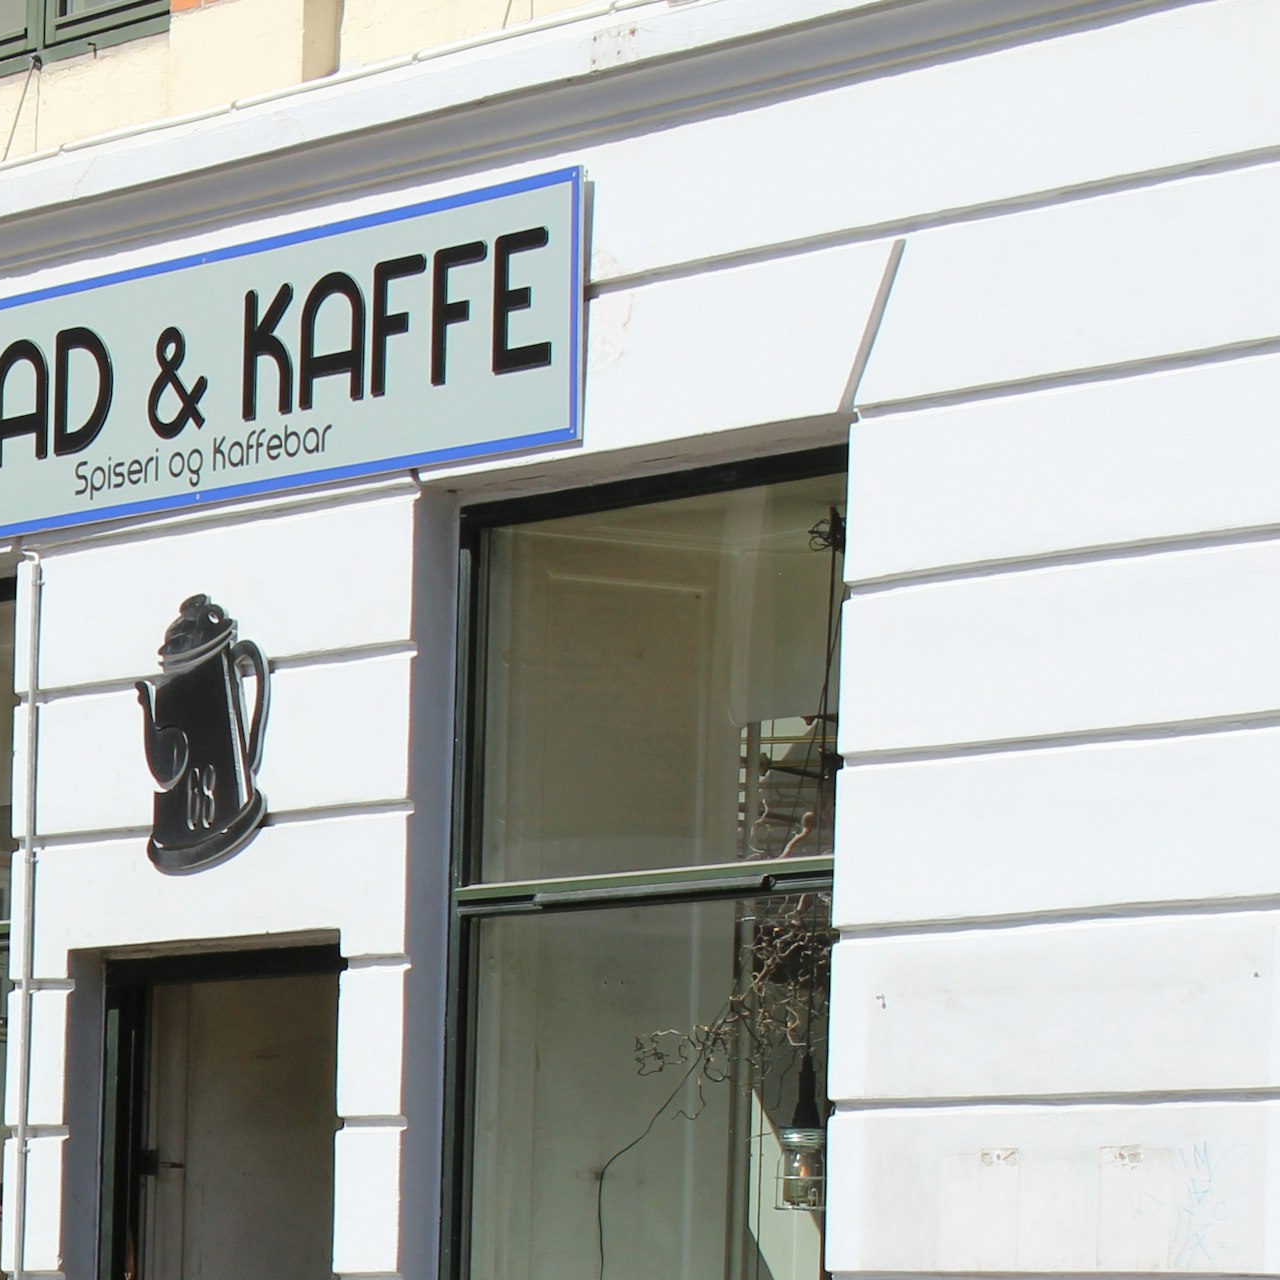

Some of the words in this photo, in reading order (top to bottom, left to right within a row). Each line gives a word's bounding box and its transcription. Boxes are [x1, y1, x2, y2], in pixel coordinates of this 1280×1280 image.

[147, 326, 208, 440] &
[242, 225, 553, 422] KAFFE
[74, 443, 161, 499] Spiseri
[168, 451, 204, 489] og
[212, 420, 335, 472] Kaffebar
